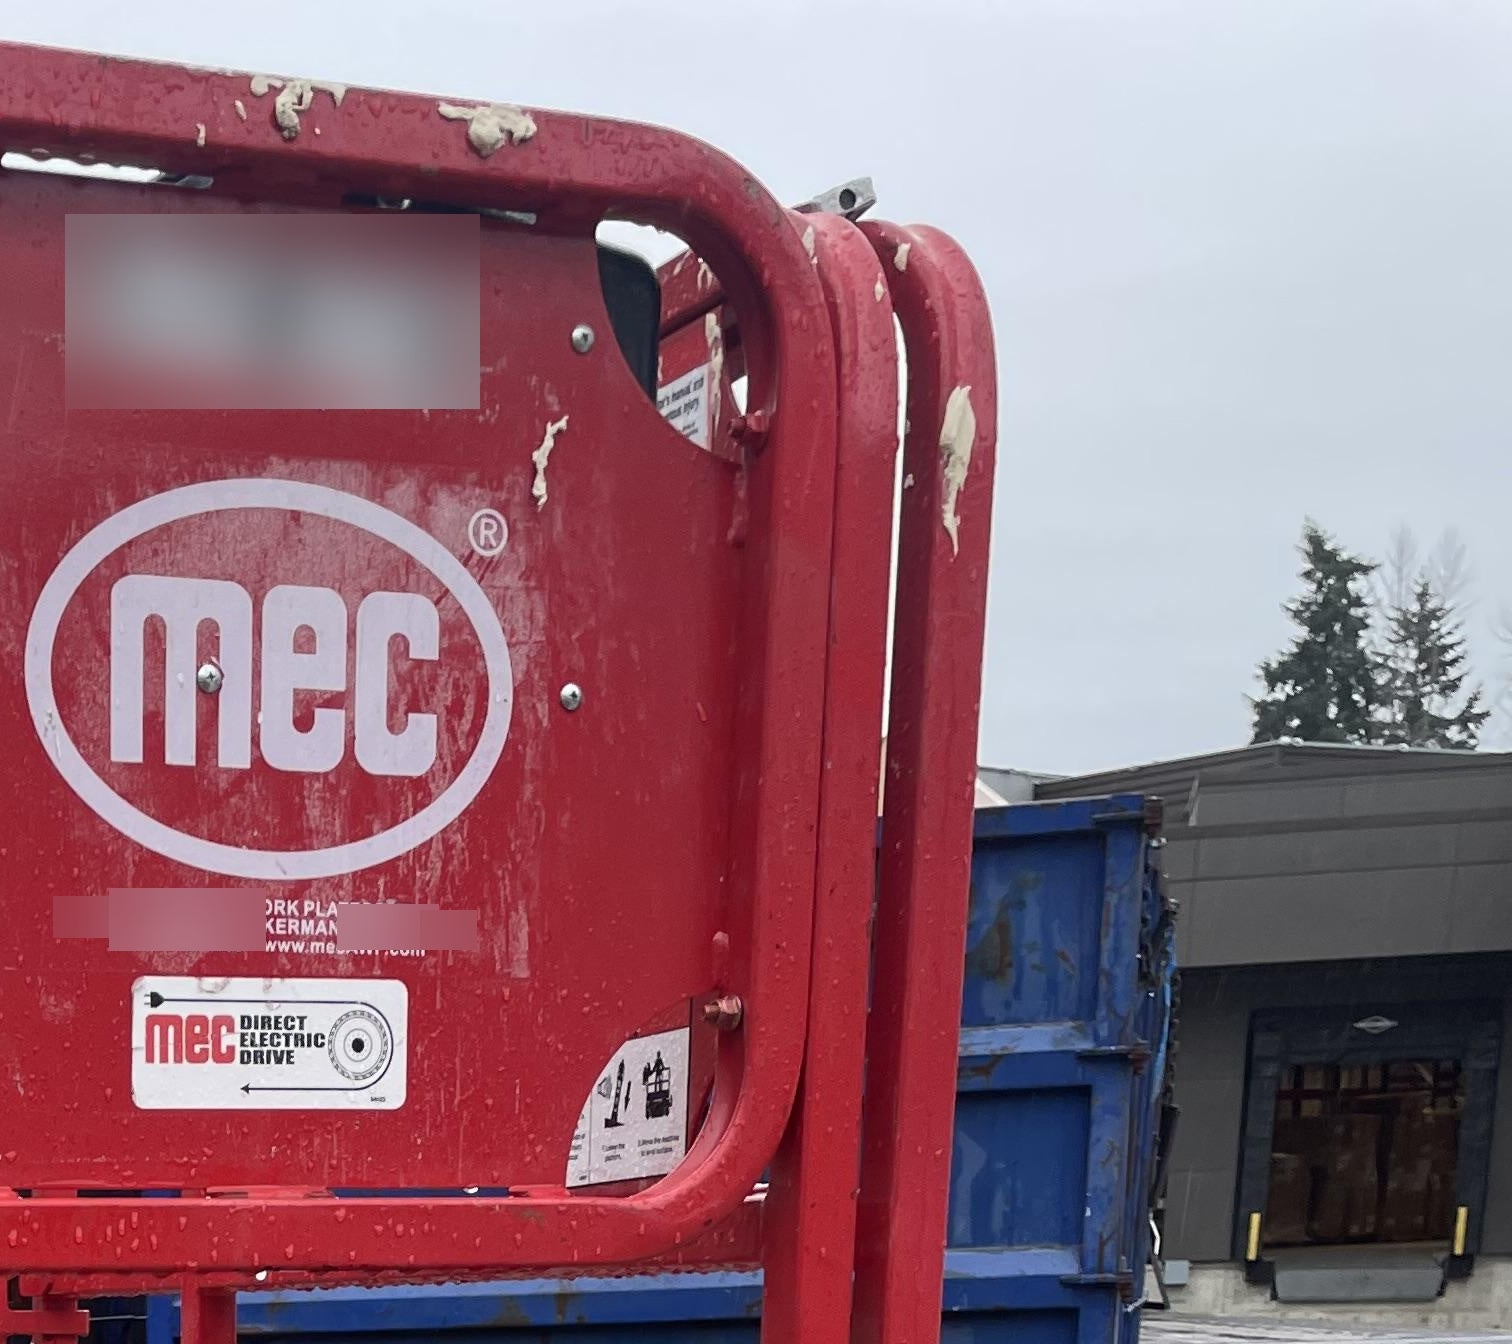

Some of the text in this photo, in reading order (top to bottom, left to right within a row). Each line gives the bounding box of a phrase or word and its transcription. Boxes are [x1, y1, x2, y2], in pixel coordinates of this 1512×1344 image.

[239, 1015, 307, 1031] DIRECT
[239, 1032, 326, 1048] ELECTRIC
[239, 1049, 295, 1065] DRIVE
